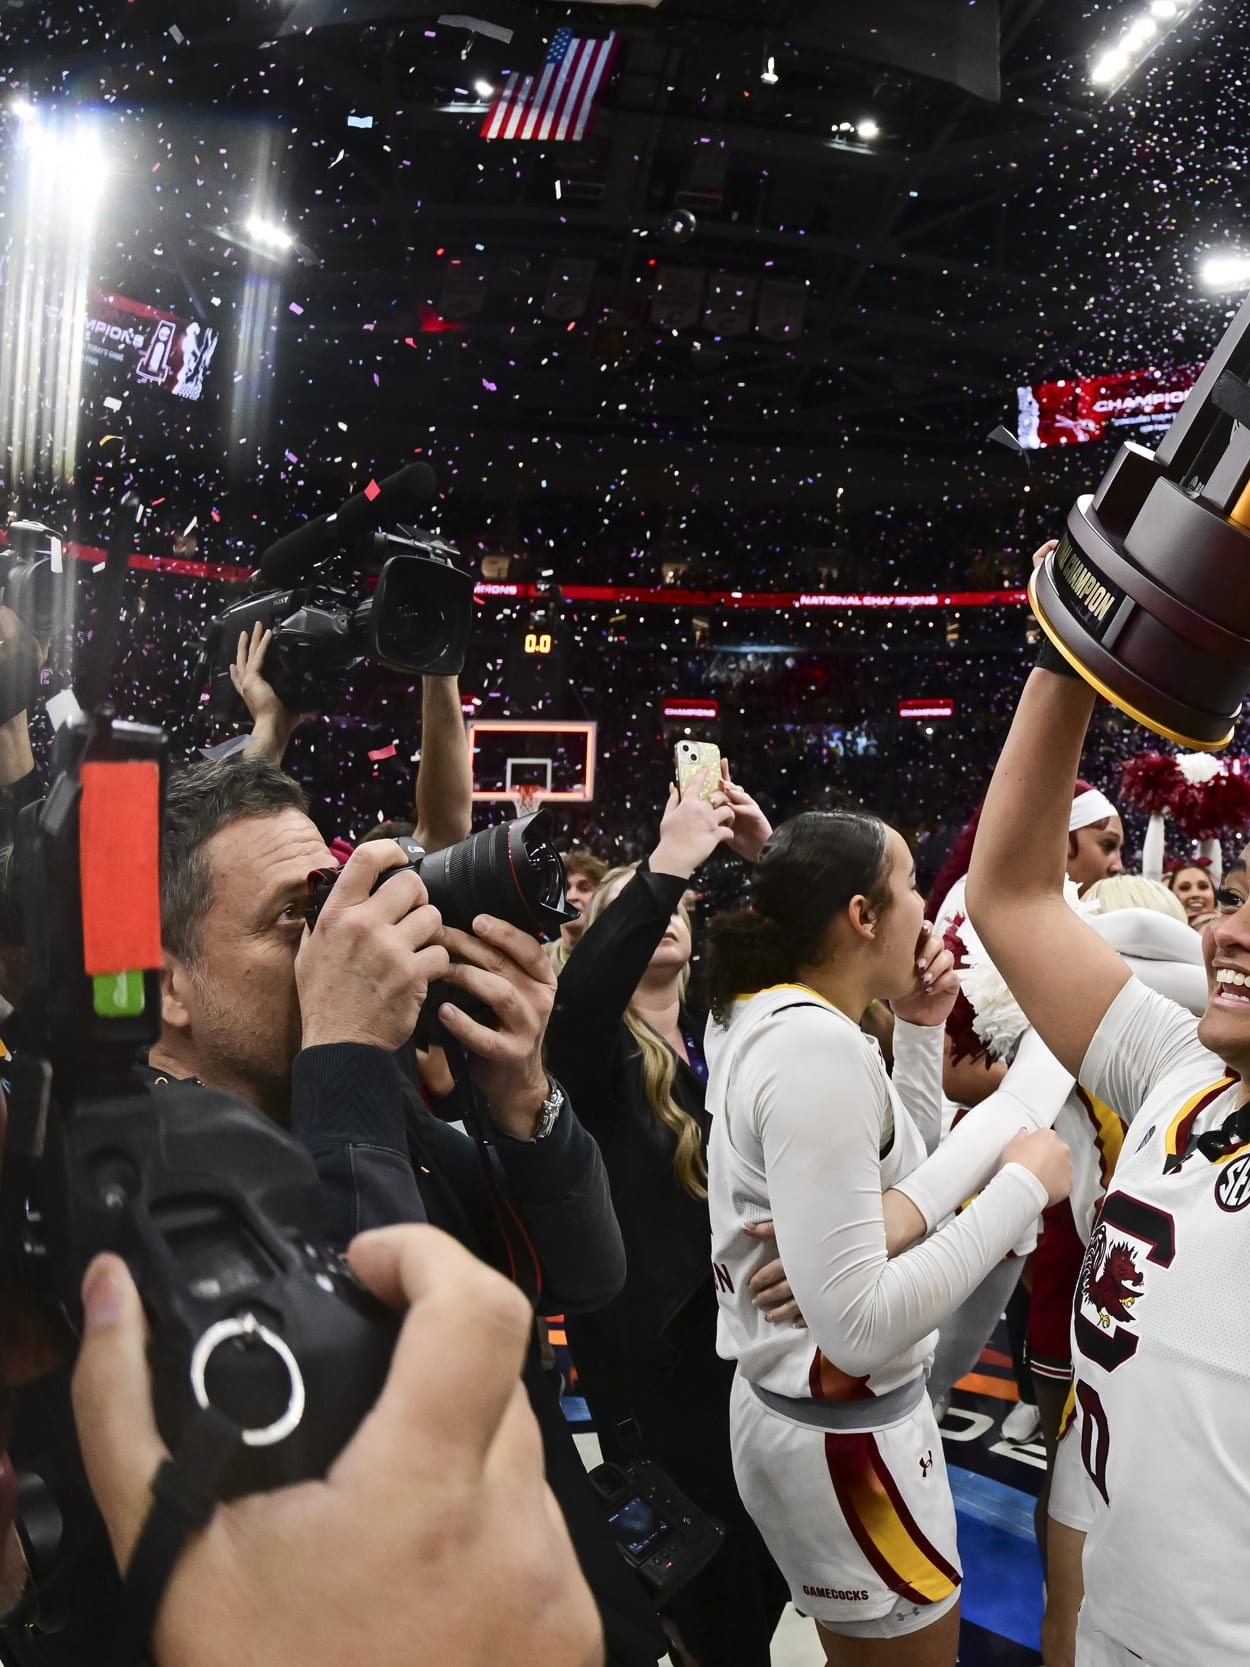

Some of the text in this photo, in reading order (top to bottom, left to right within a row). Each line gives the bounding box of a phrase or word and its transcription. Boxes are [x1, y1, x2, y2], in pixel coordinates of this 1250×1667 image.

[1062, 552, 1116, 621] CHAMPION
[525, 633, 551, 653] 0.0
[802, 1585, 869, 1601] GAMECOCKS
